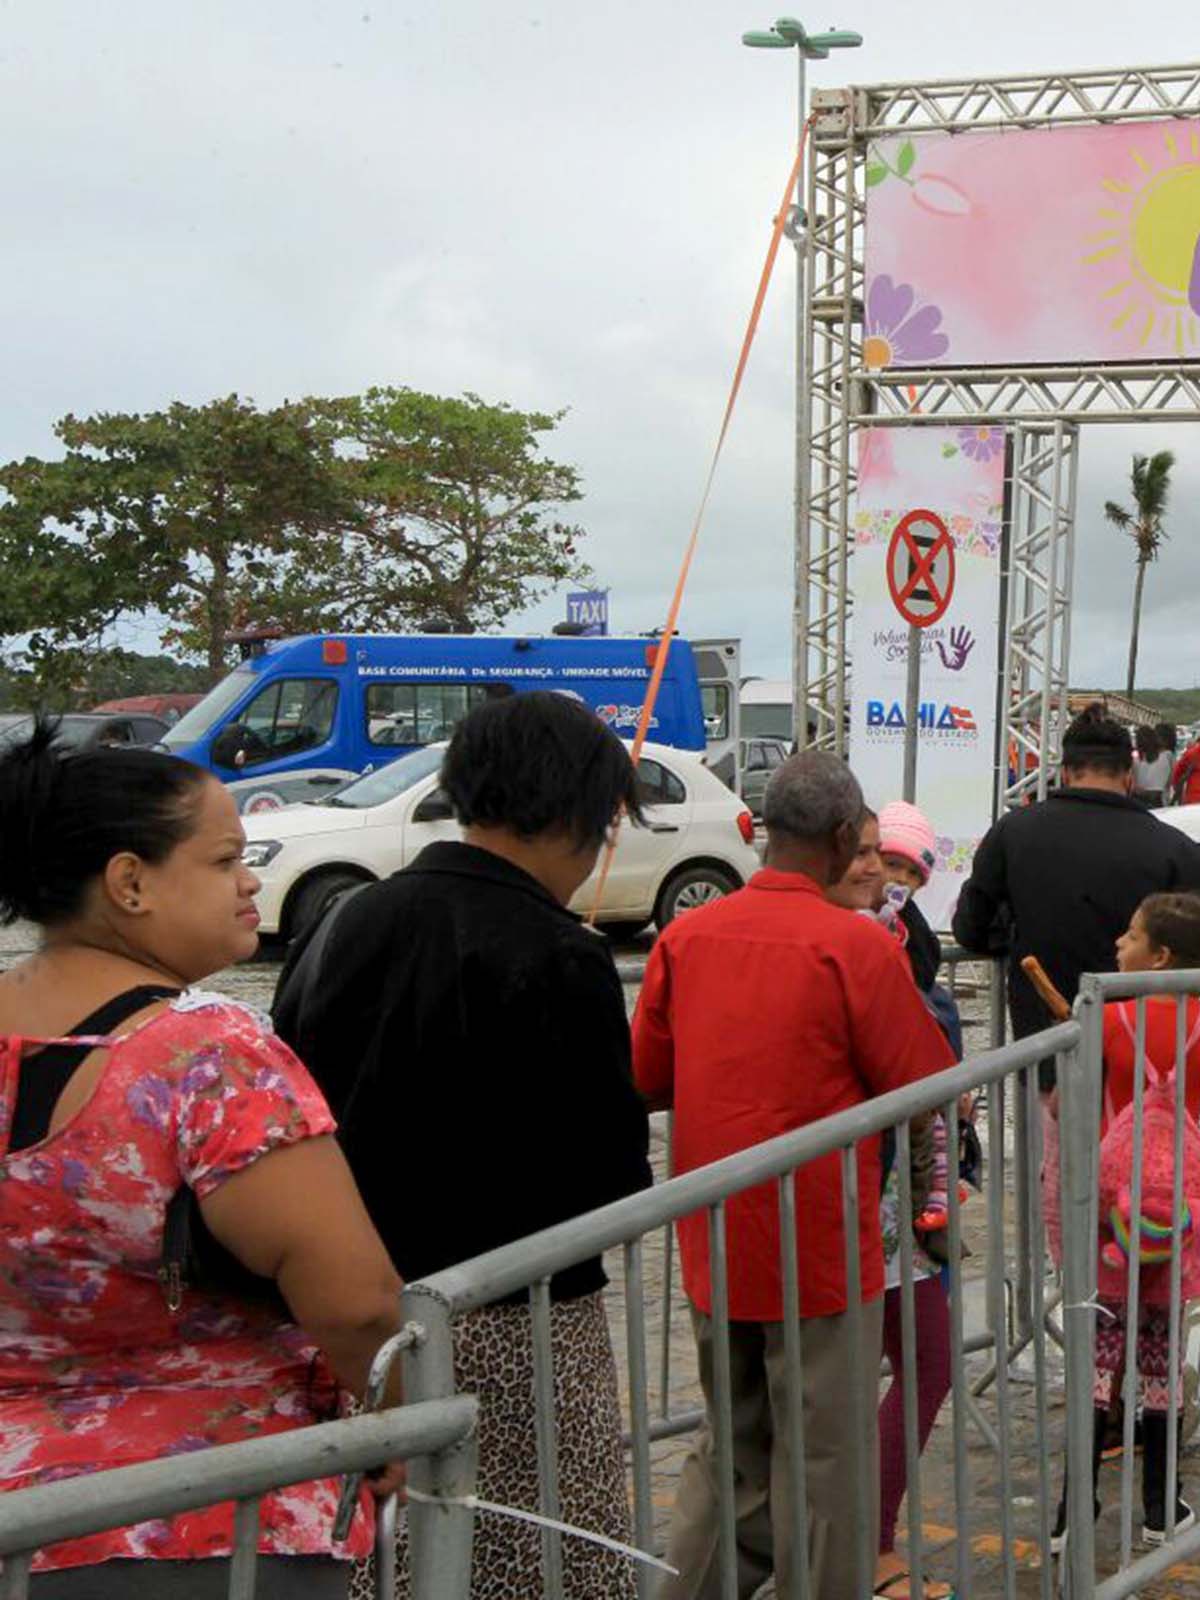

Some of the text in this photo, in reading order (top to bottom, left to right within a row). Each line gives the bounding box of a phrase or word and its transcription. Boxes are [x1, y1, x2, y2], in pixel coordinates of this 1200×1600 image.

[570, 600, 606, 624] TAXI
[874, 629, 946, 647] Volunrias
[886, 642, 934, 661] Socis
[358, 666, 386, 676] BASE
[389, 665, 466, 676] COMUNITÁRIA
[489, 667, 554, 678] SEGURANÇA
[561, 667, 610, 676] UNIDADE
[612, 666, 648, 677] MÓVEL
